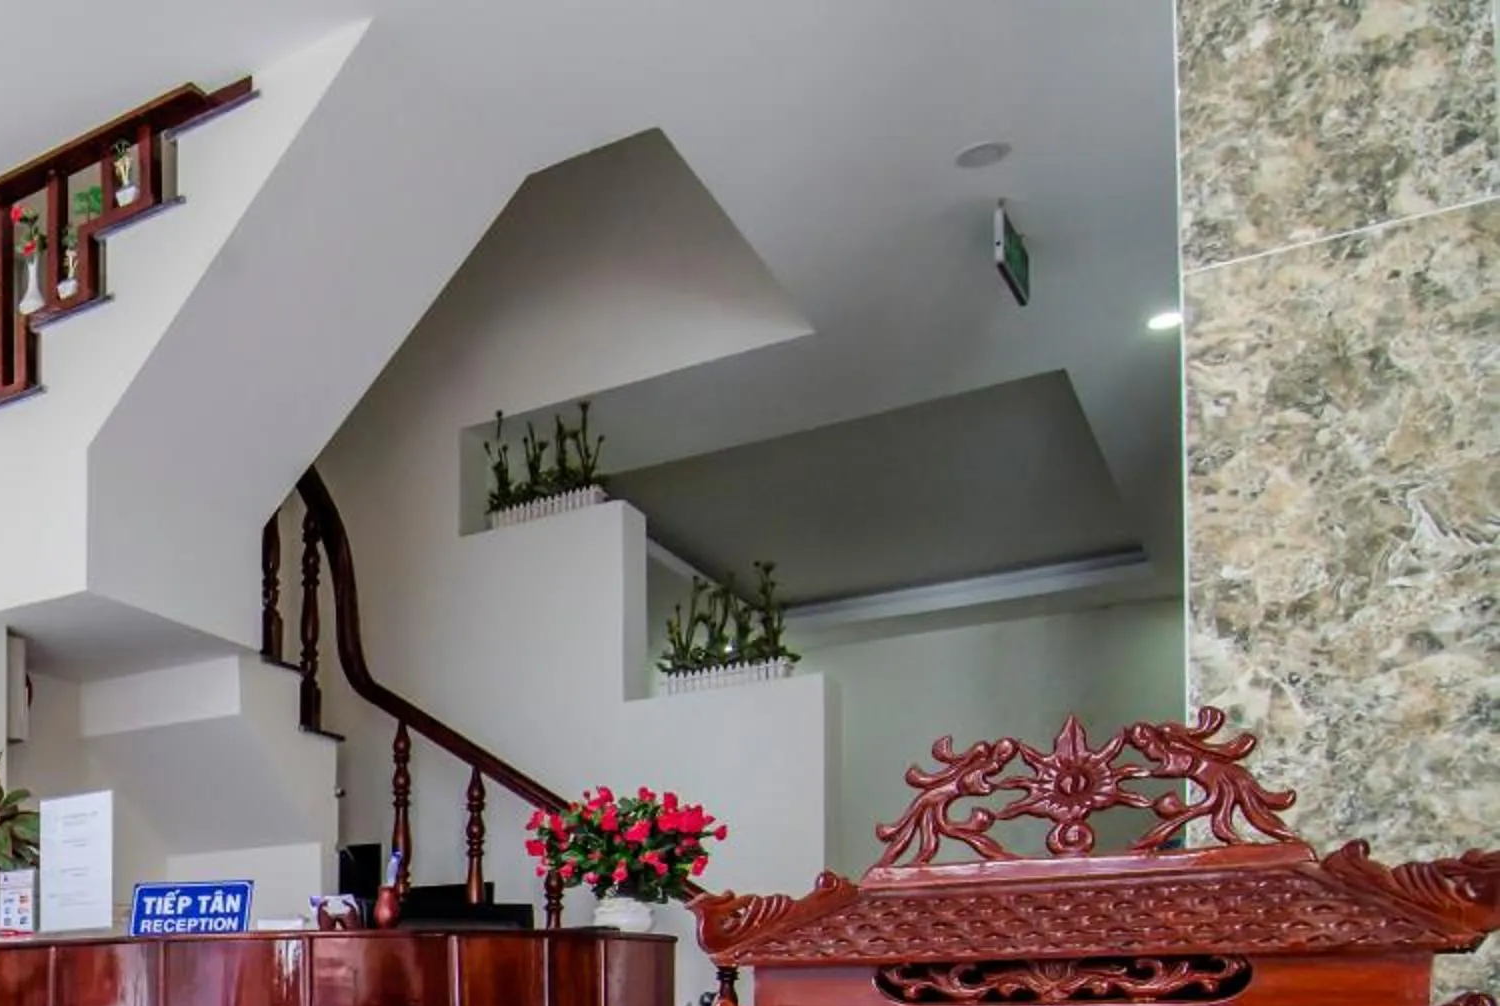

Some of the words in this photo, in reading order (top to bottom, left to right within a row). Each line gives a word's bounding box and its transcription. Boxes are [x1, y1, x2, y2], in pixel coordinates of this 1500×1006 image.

[143, 889, 192, 915] TIẾP
[197, 889, 242, 914] TÂN
[140, 916, 240, 933] RECEPTION
